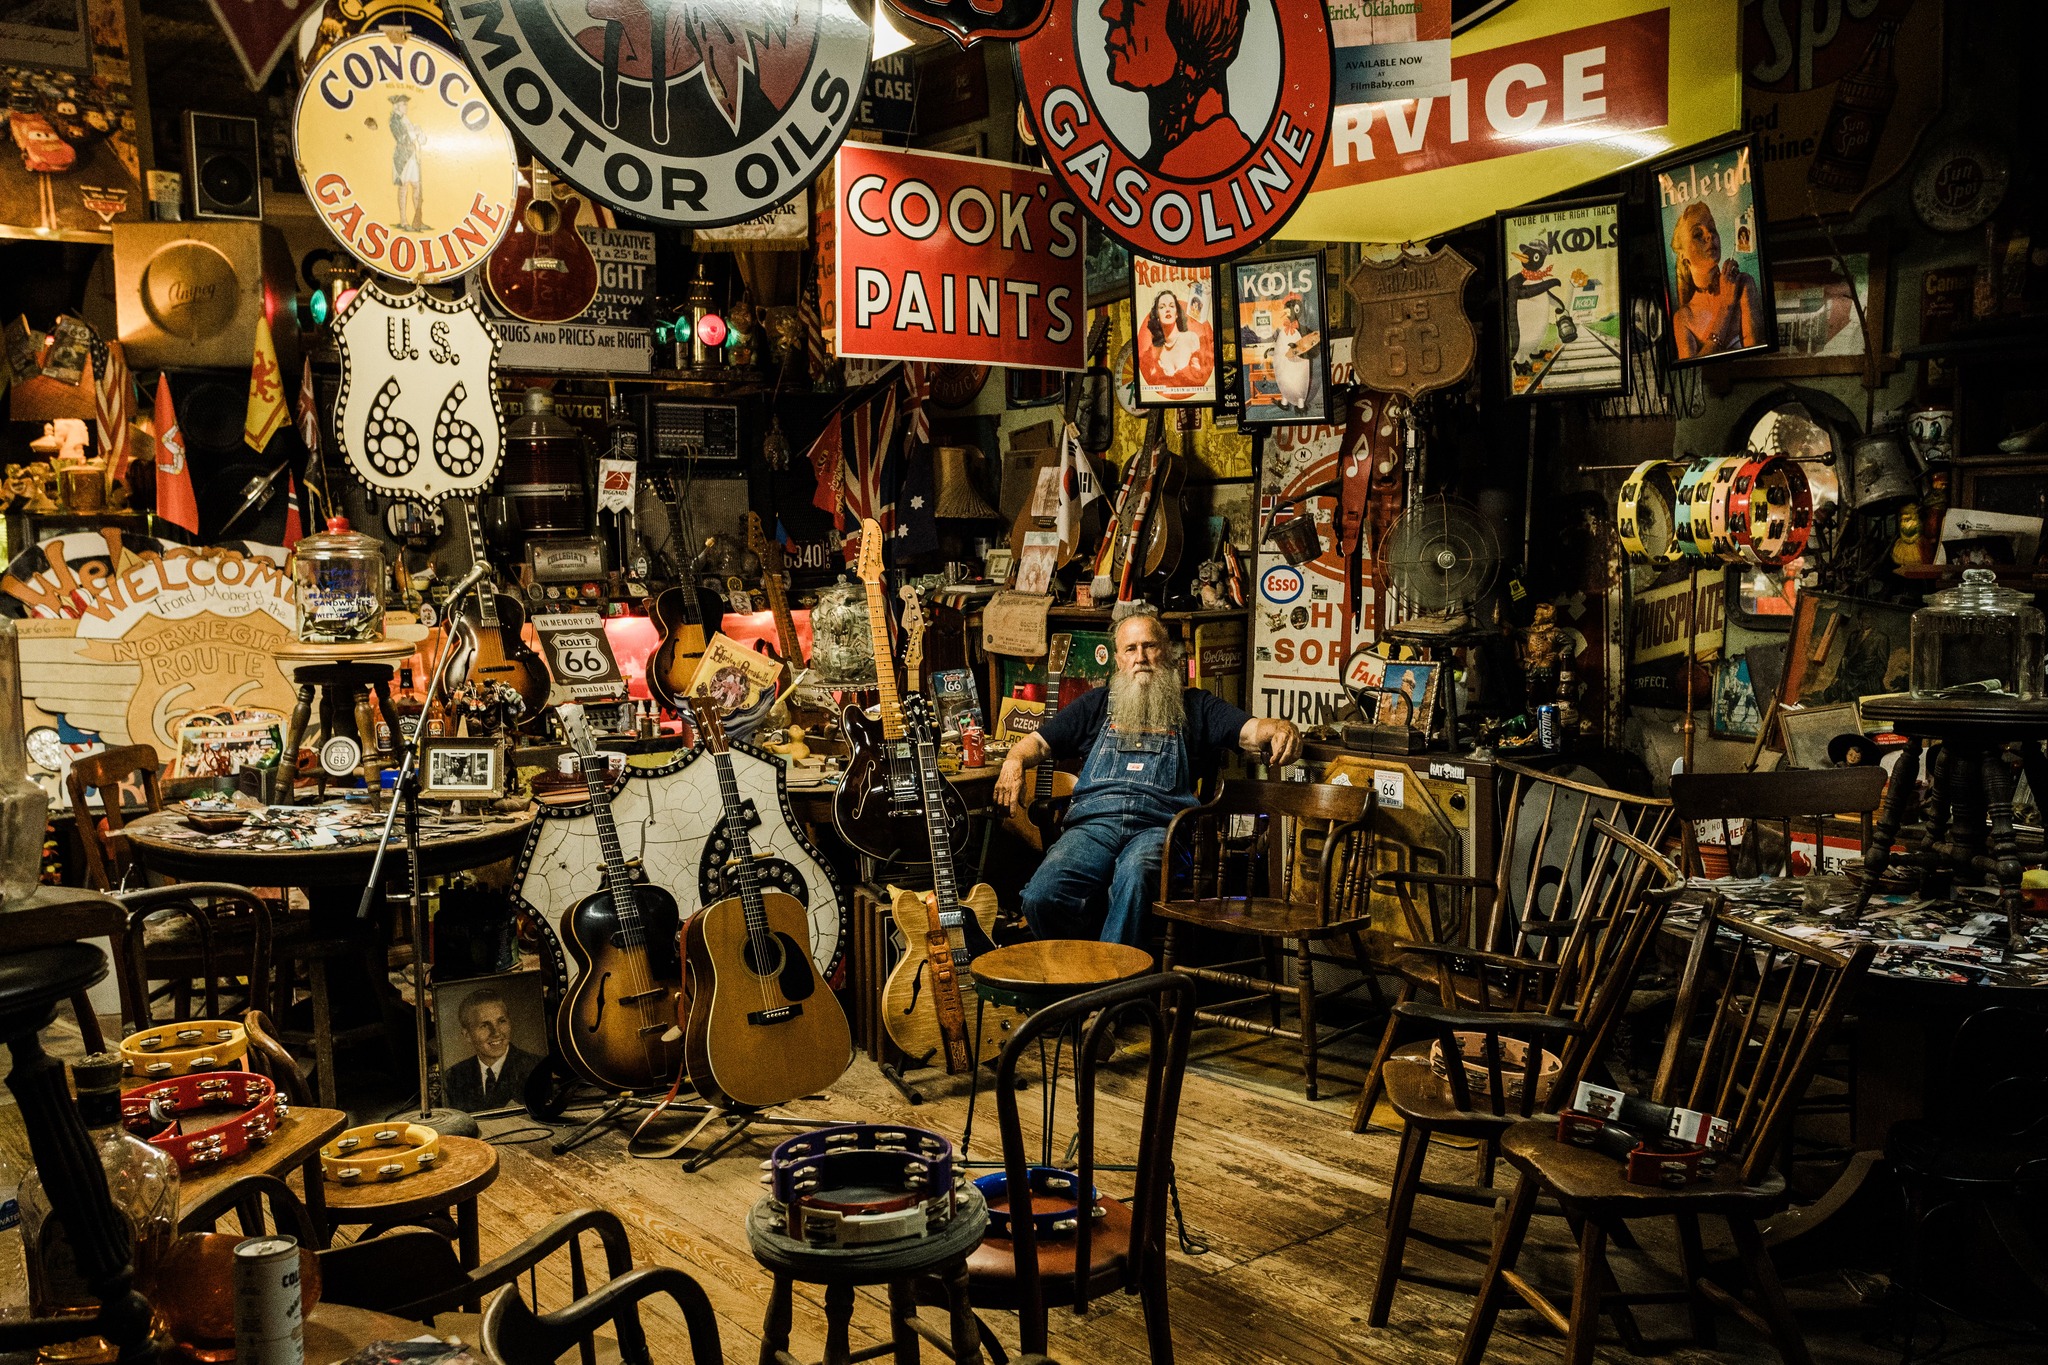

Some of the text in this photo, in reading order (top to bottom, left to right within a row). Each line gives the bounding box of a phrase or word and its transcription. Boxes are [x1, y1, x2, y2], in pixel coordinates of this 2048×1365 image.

[1328, 0, 1423, 21] Erick, Oklahoma
[871, 55, 905, 76] AIN
[1344, 56, 1423, 70] AVAILABLE NOW
[319, 45, 490, 132] CONOCO
[875, 78, 913, 101] CASE
[1350, 79, 1415, 91] FilmBaby.com
[460, 3, 850, 212] MOTOR OILS
[1332, 46, 1607, 168] RVICE
[1041, 85, 1314, 245] GASOLINE
[1658, 147, 1752, 208] Raleigh
[315, 173, 505, 273] GASOLINE
[847, 174, 1078, 260] COOK'S
[1513, 206, 1616, 227] YOU'RE ON THE RIGHT TRACK
[602, 231, 651, 250] LAXATIVE
[1547, 223, 1618, 255] KOOLS
[633, 251, 649, 261] Box
[598, 261, 647, 291] IGHT
[1243, 268, 1313, 298] KOOLS
[1377, 267, 1439, 295] ARIZONA
[169, 281, 215, 308] Ampeg
[593, 292, 644, 306] orrow
[855, 266, 1075, 345] PAINTS
[533, 332, 556, 344] AND
[559, 327, 596, 346] PRICES
[598, 336, 616, 348] ARE
[617, 331, 646, 349] RIGHT
[1384, 323, 1442, 377] 66
[554, 403, 603, 419] RVICE
[364, 374, 484, 478] 66
[1300, 451, 1307, 459] N
[149, 591, 196, 615] Trond
[202, 585, 265, 606] Moberg
[228, 600, 287, 620] and the
[540, 617, 595, 627] IN MEMORY OF
[112, 619, 296, 662] NORWEGIA
[559, 638, 592, 647] ROUTE
[151, 648, 265, 686] ROUTE
[565, 649, 602, 673] 66
[570, 682, 616, 694] Annabelle
[947, 682, 961, 692] 66
[1013, 717, 1040, 731] CZECH
[1541, 711, 1553, 750] KEYSTONE
[333, 756, 346, 765] 66
[1430, 762, 1465, 780] RAT ROD
[1382, 783, 1395, 797] 66
[1814, 855, 1834, 869] HE
